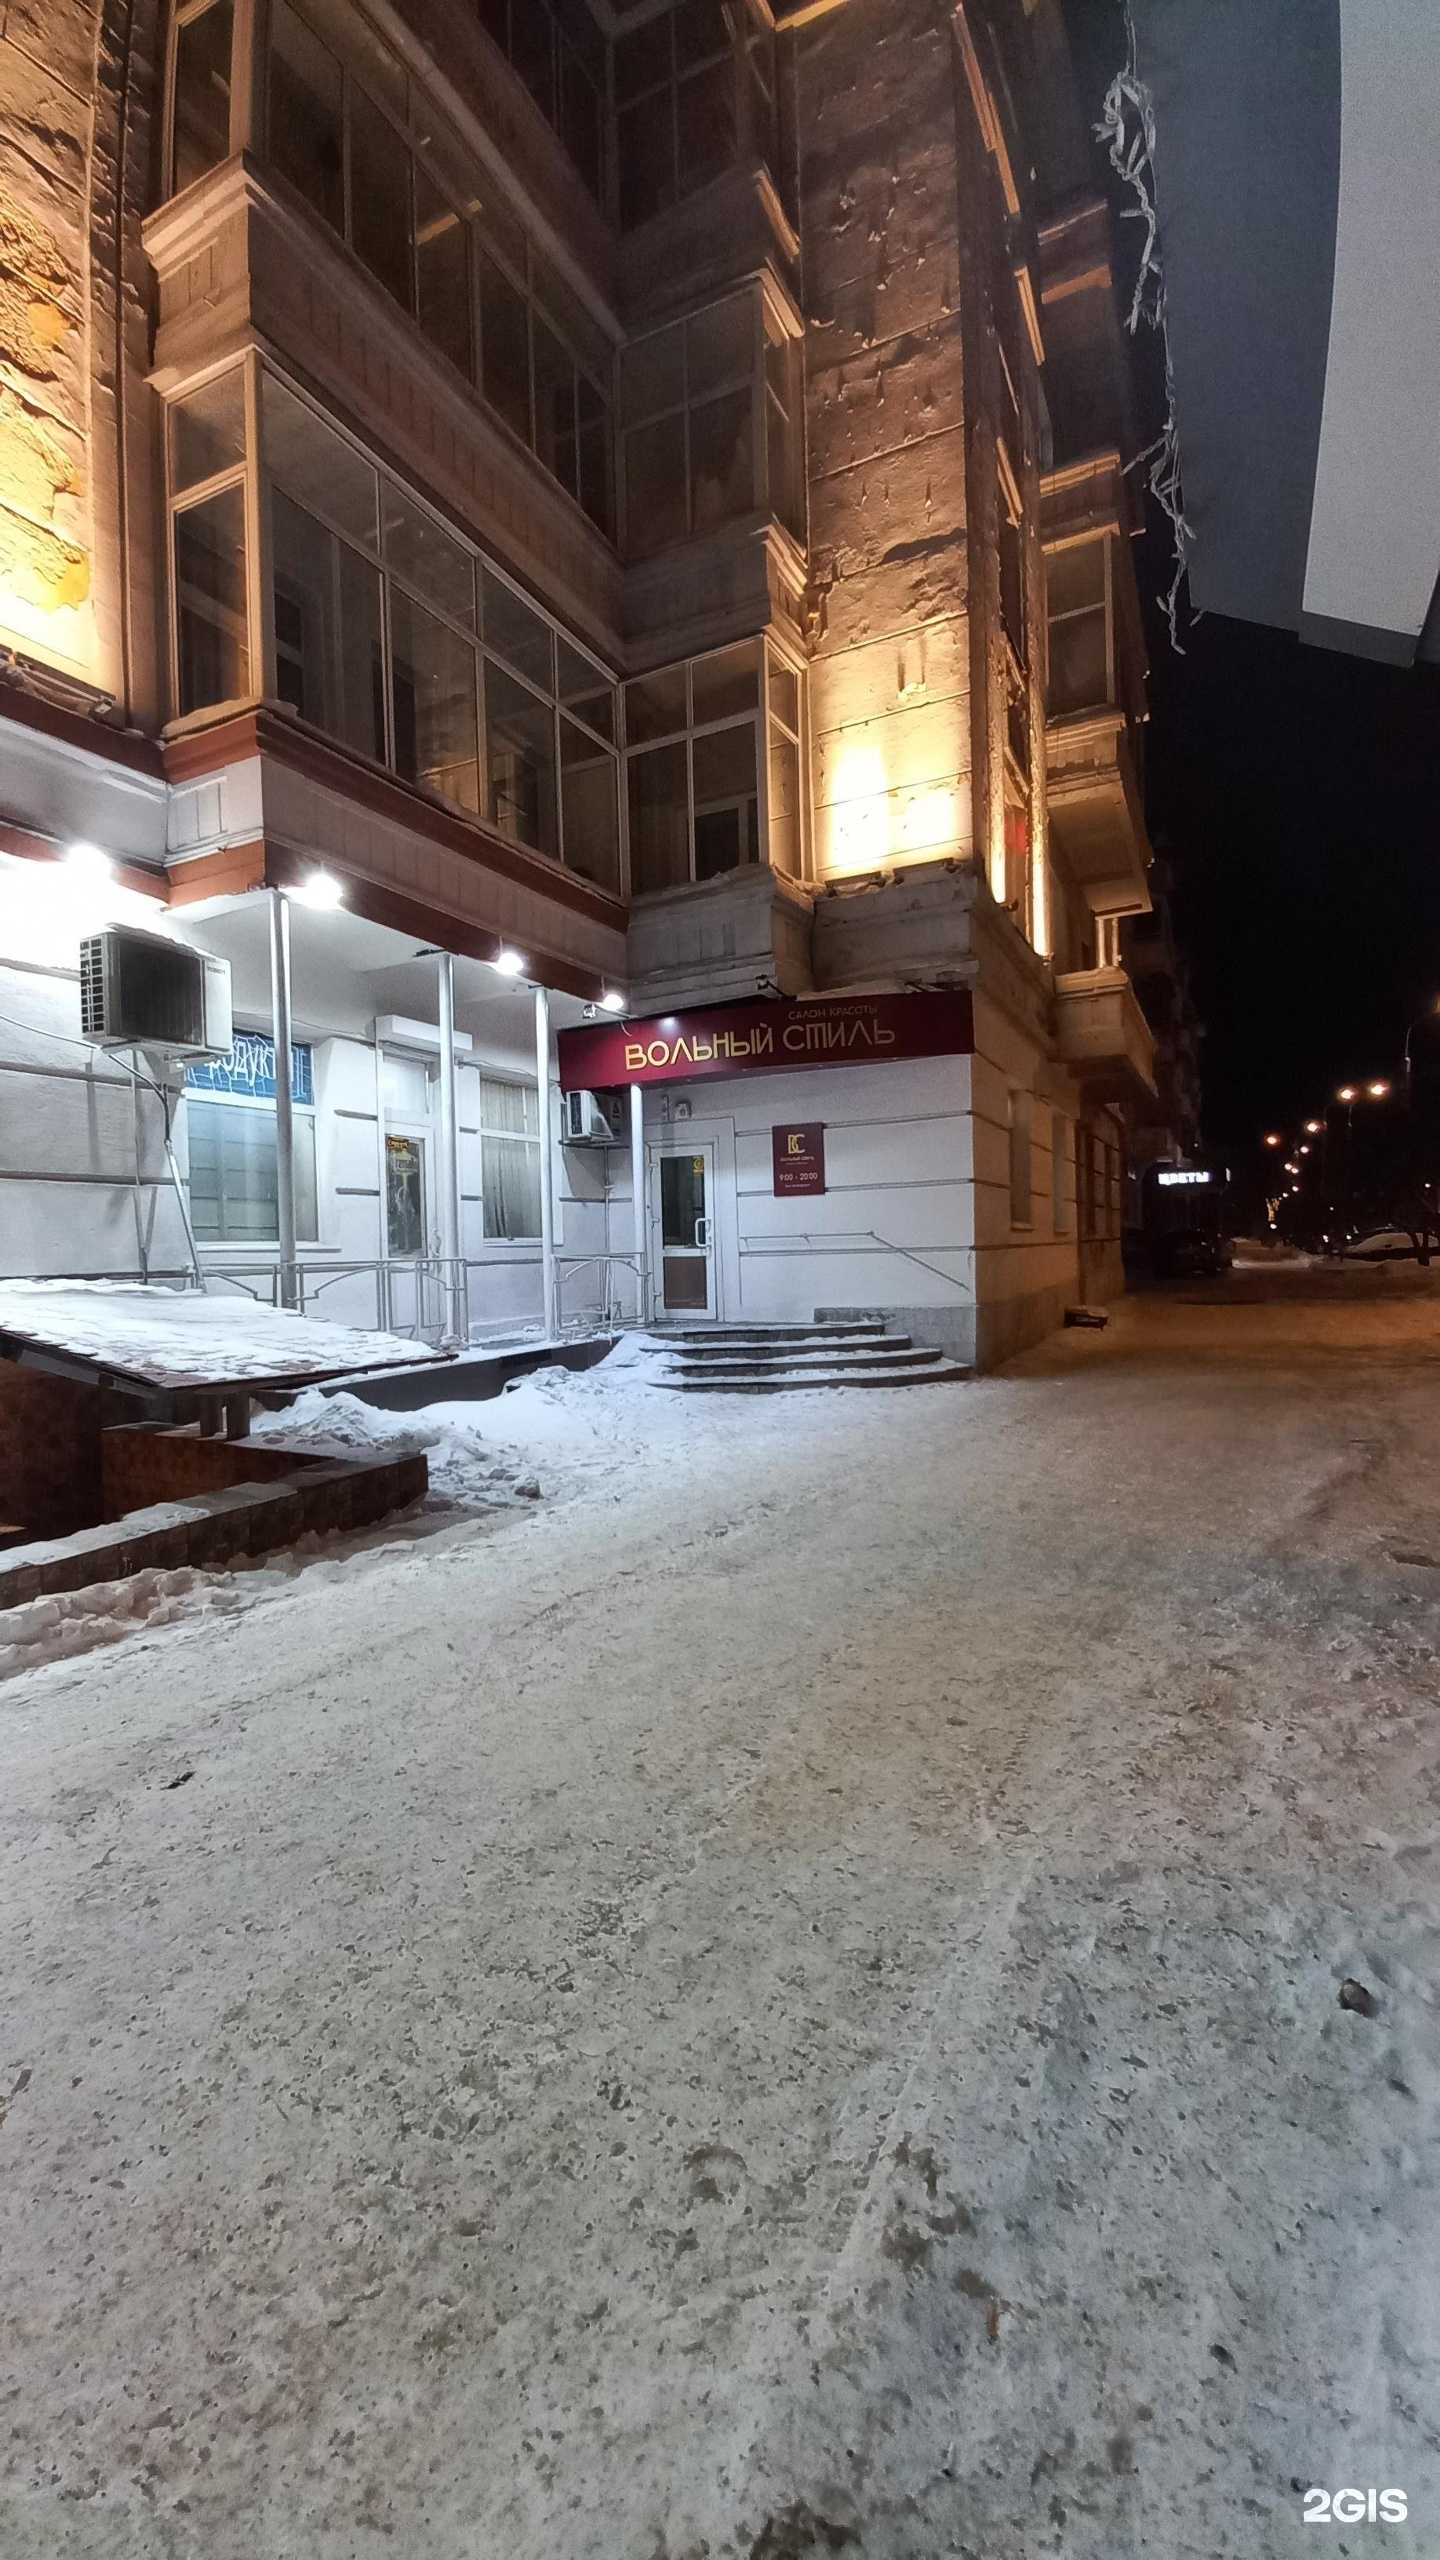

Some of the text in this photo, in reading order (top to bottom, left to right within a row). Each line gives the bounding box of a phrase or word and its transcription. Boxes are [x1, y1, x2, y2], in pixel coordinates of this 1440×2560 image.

[788, 1005, 878, 1020] САЛОН КРАСОТЫ
[624, 1019, 896, 1071] ВОЛЬНЫЙ СТИЛЬ
